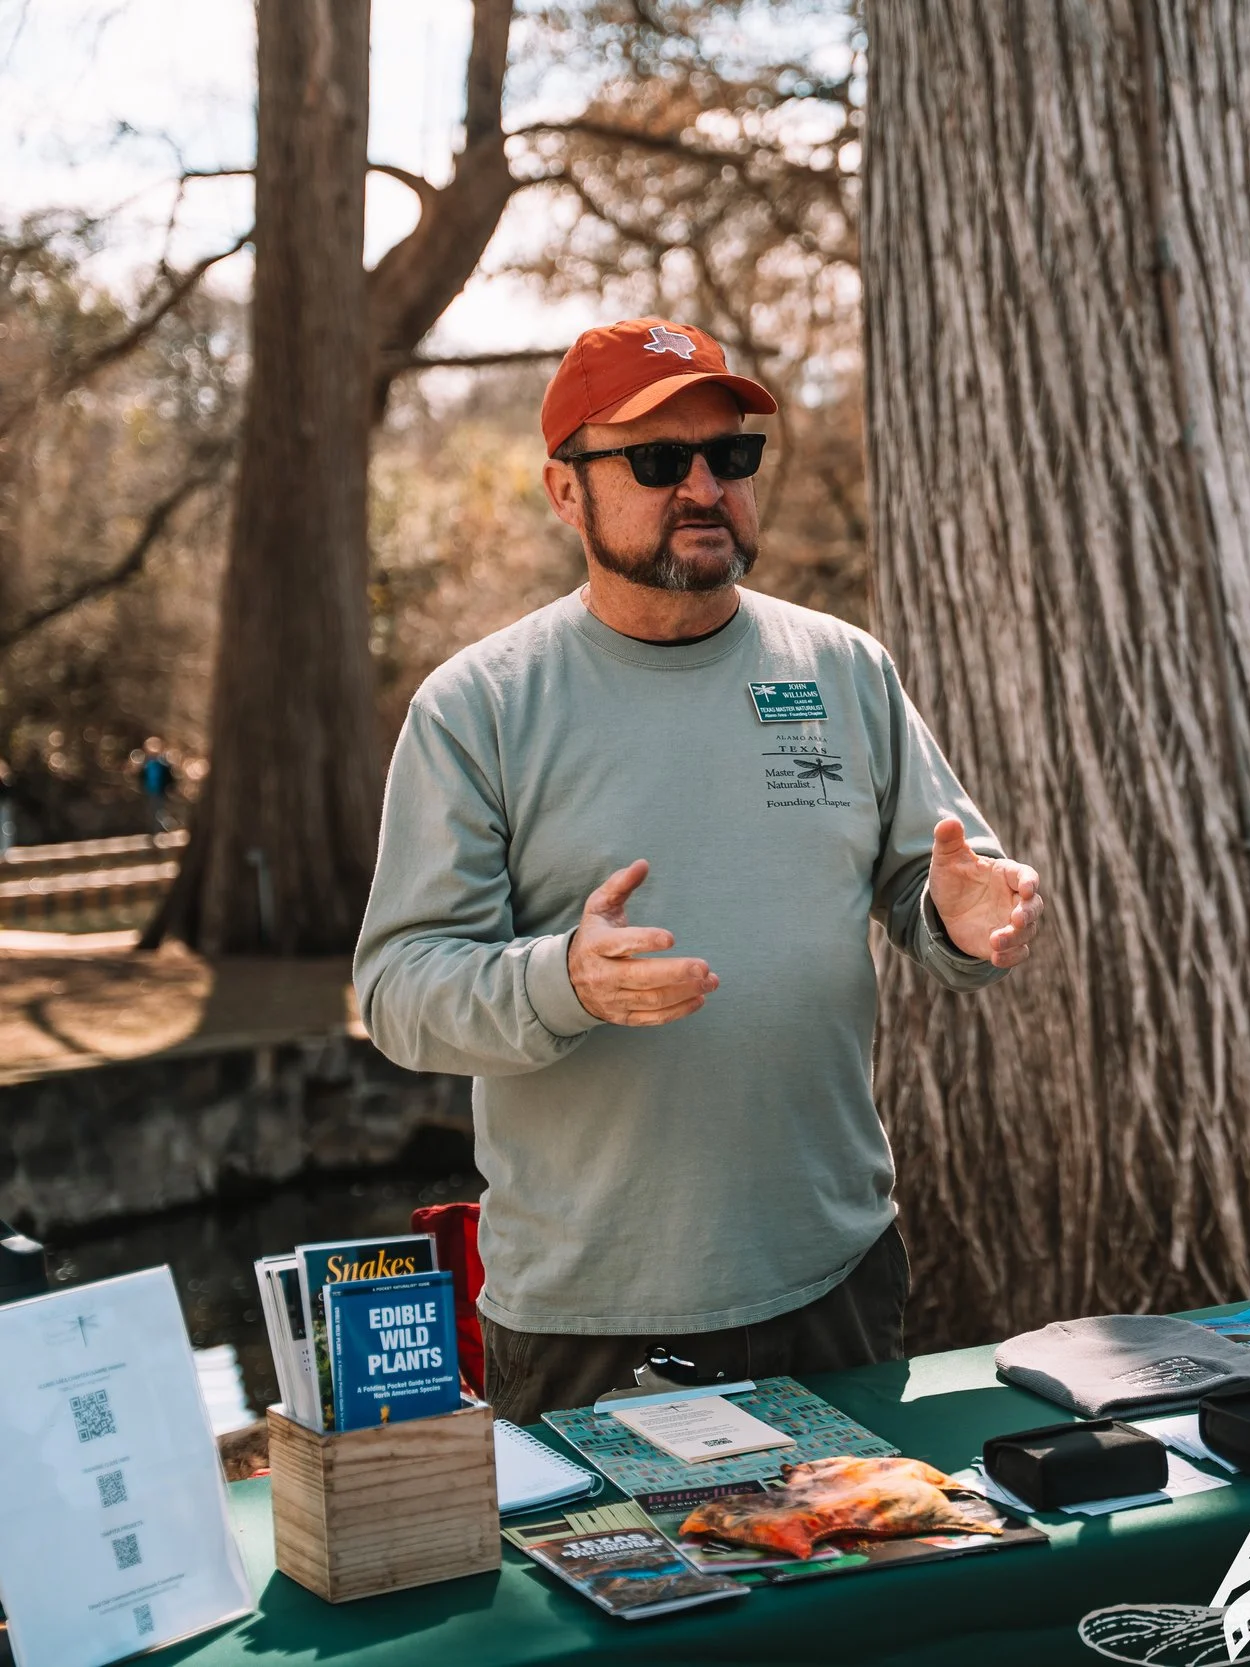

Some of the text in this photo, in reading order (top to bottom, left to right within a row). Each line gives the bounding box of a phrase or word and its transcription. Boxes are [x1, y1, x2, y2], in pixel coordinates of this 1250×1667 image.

[779, 745, 827, 755] TEXAS
[765, 768, 795, 778] Master
[766, 780, 810, 790] Naturalist
[766, 797, 851, 808] Founding Chapter
[326, 1250, 415, 1284] Snakes
[369, 1303, 437, 1329] EDIBLE
[379, 1327, 429, 1351] WILD
[368, 1347, 442, 1376] PLANTS
[362, 1384, 386, 1393] Folding
[386, 1381, 408, 1390] Pocket
[407, 1379, 425, 1387] Guide
[424, 1377, 432, 1385] to
[431, 1375, 454, 1384] Familiar
[373, 1385, 441, 1400] North American Species
[563, 1534, 646, 1550] TEXAS
